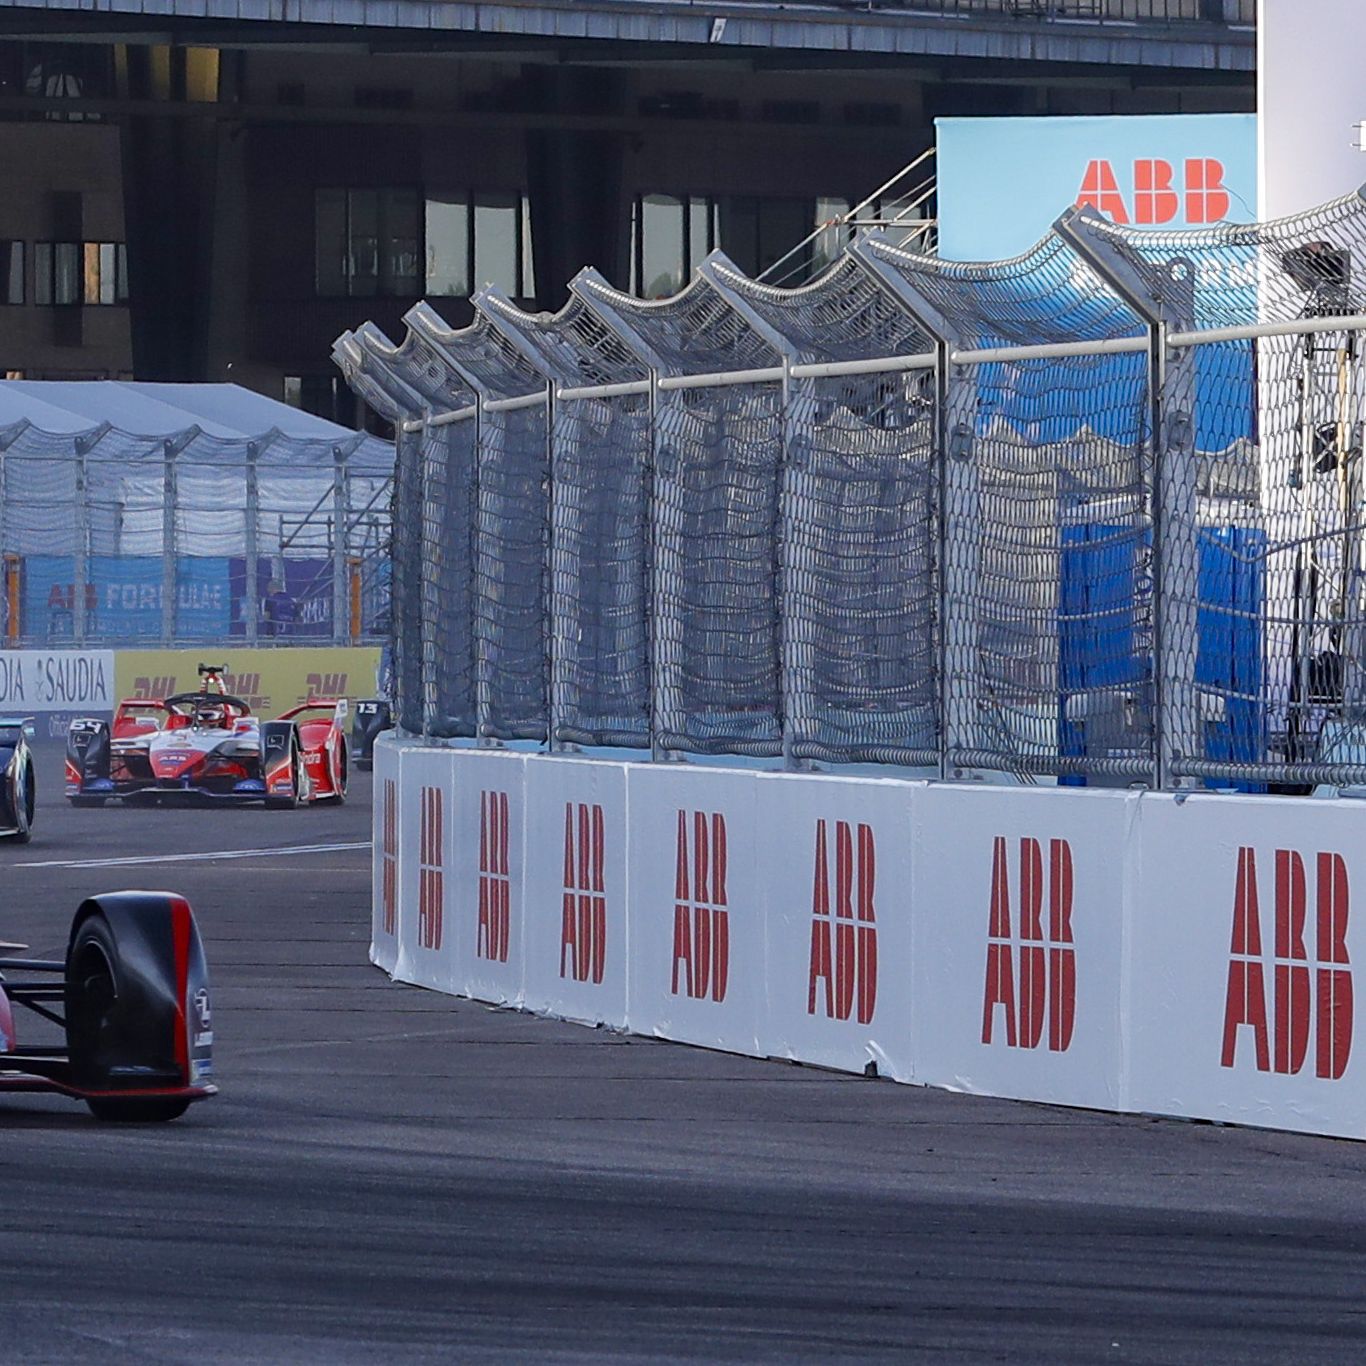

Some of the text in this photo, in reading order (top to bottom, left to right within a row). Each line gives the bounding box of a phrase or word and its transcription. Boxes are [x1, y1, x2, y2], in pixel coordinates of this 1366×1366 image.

[1075, 158, 1230, 224] ABB
[45, 657, 107, 702] SAUDIA
[69, 718, 103, 734] 64
[306, 673, 349, 697] DHL
[357, 703, 378, 715] 13
[418, 785, 444, 951] ABB
[477, 790, 510, 964] ABB
[559, 802, 607, 985] ABB
[672, 809, 729, 1004] ABB
[808, 818, 879, 1026] ABB
[982, 836, 1077, 1053] ABB
[1221, 846, 1355, 1081] ABB
